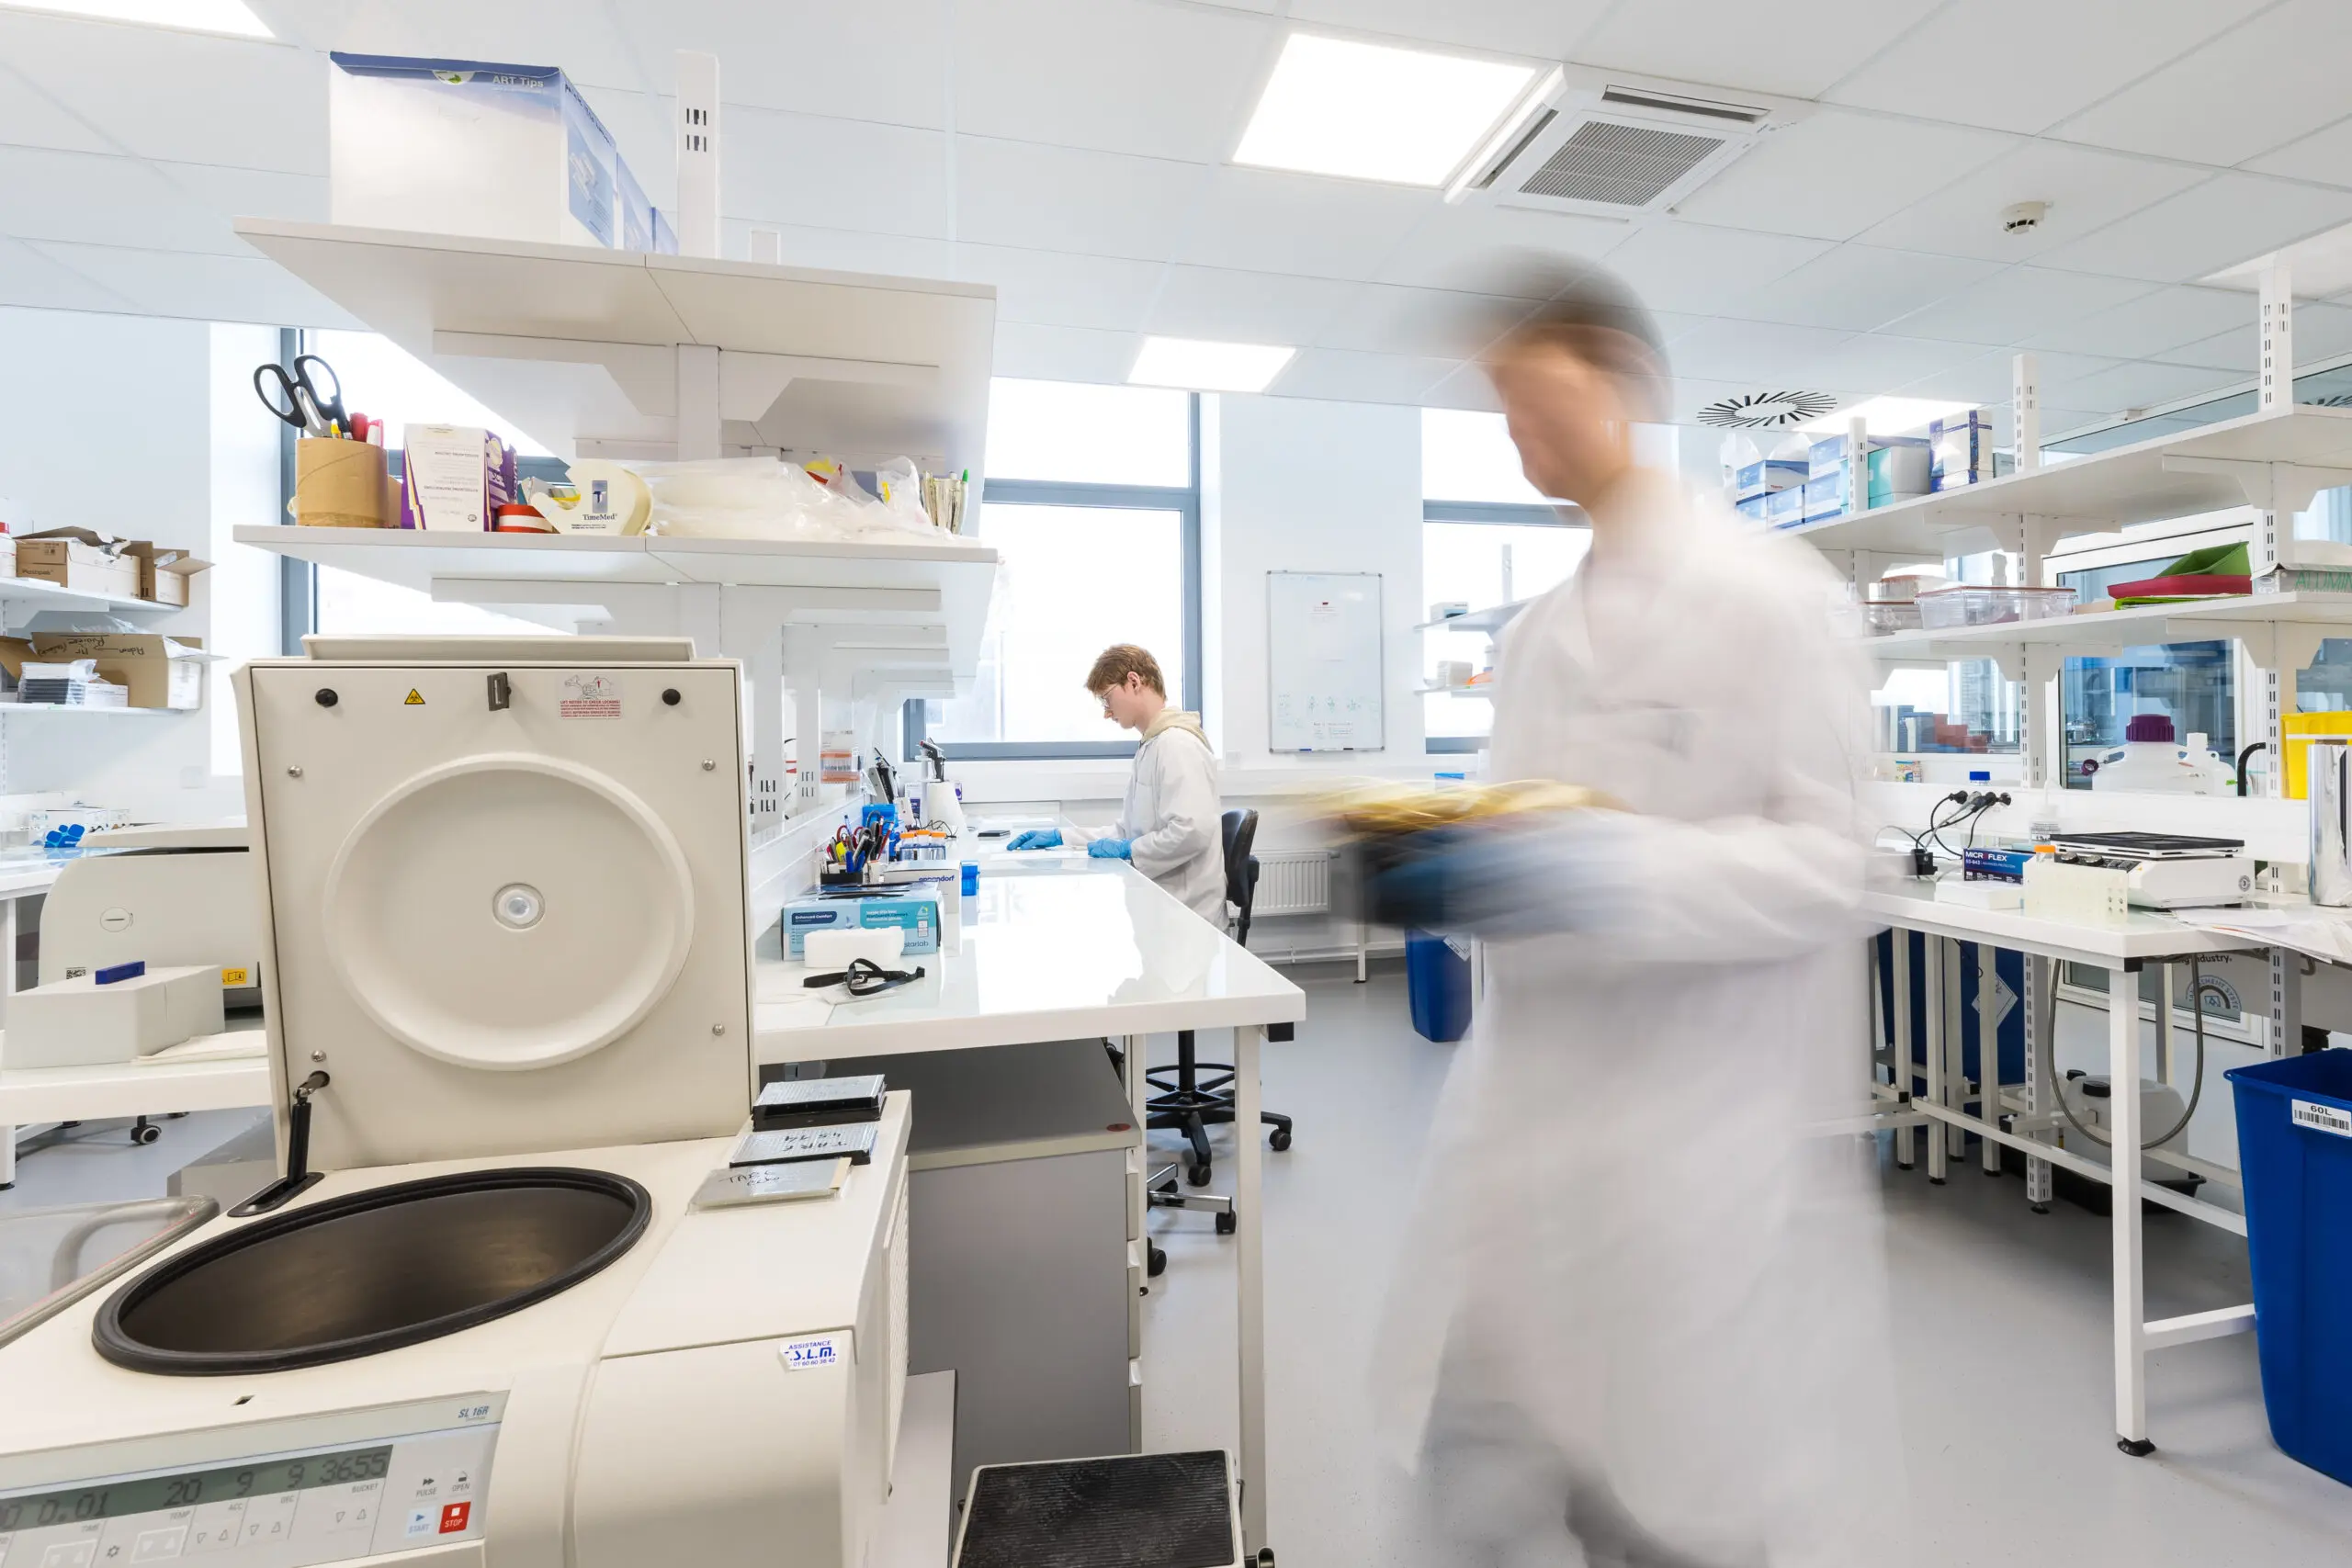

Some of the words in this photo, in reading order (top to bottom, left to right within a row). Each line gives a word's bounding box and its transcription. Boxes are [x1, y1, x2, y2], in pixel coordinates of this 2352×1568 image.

[492, 75, 516, 85] ART
[520, 77, 544, 88] Tips
[2195, 953, 2233, 964] ndustry.
[2311, 1105, 2333, 1116] 60L
[788, 1340, 831, 1349] ASSISTANCE
[352, 1483, 379, 1494] BUCKET
[416, 1488, 437, 1497] PULSE
[452, 1483, 470, 1492] OPEN
[37, 1492, 108, 1526] 0.01
[164, 1478, 202, 1506] 20
[235, 1471, 254, 1497] 9
[288, 1464, 305, 1488] 9
[169, 1510, 190, 1520] TEMP
[445, 1518, 462, 1528] STOP
[408, 1524, 431, 1533] START
